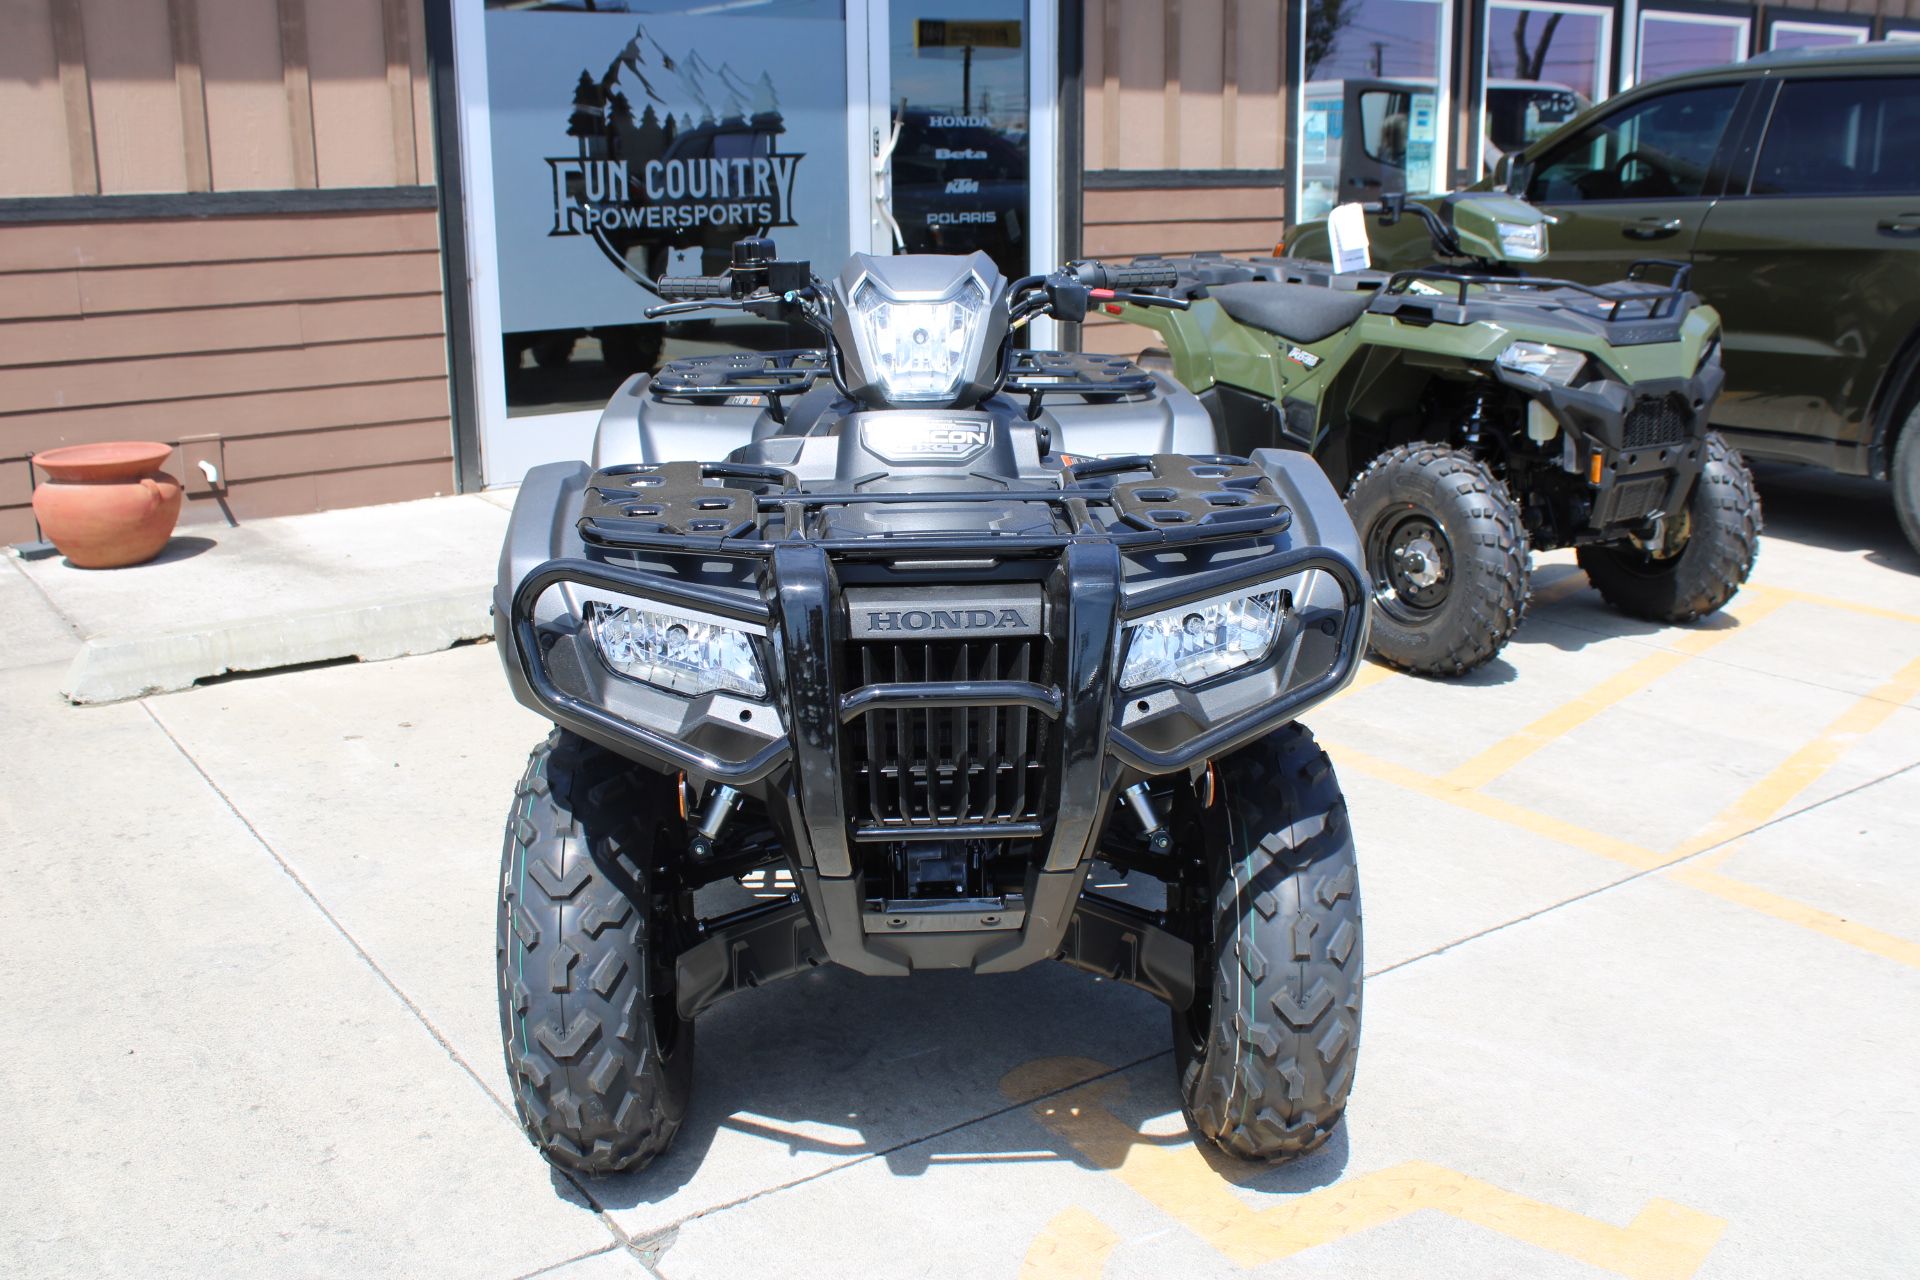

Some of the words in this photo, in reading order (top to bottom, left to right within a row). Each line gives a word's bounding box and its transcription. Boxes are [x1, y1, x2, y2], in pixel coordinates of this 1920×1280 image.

[929, 115, 993, 128] HONDA
[935, 148, 988, 160] Beta
[944, 178, 979, 194] KTM
[554, 159, 630, 233] FUN
[645, 157, 798, 224] COUNTRY
[588, 203, 773, 231] POWERSPORTS
[926, 211, 997, 224] POLARIS
[867, 609, 1029, 631] HONDA
